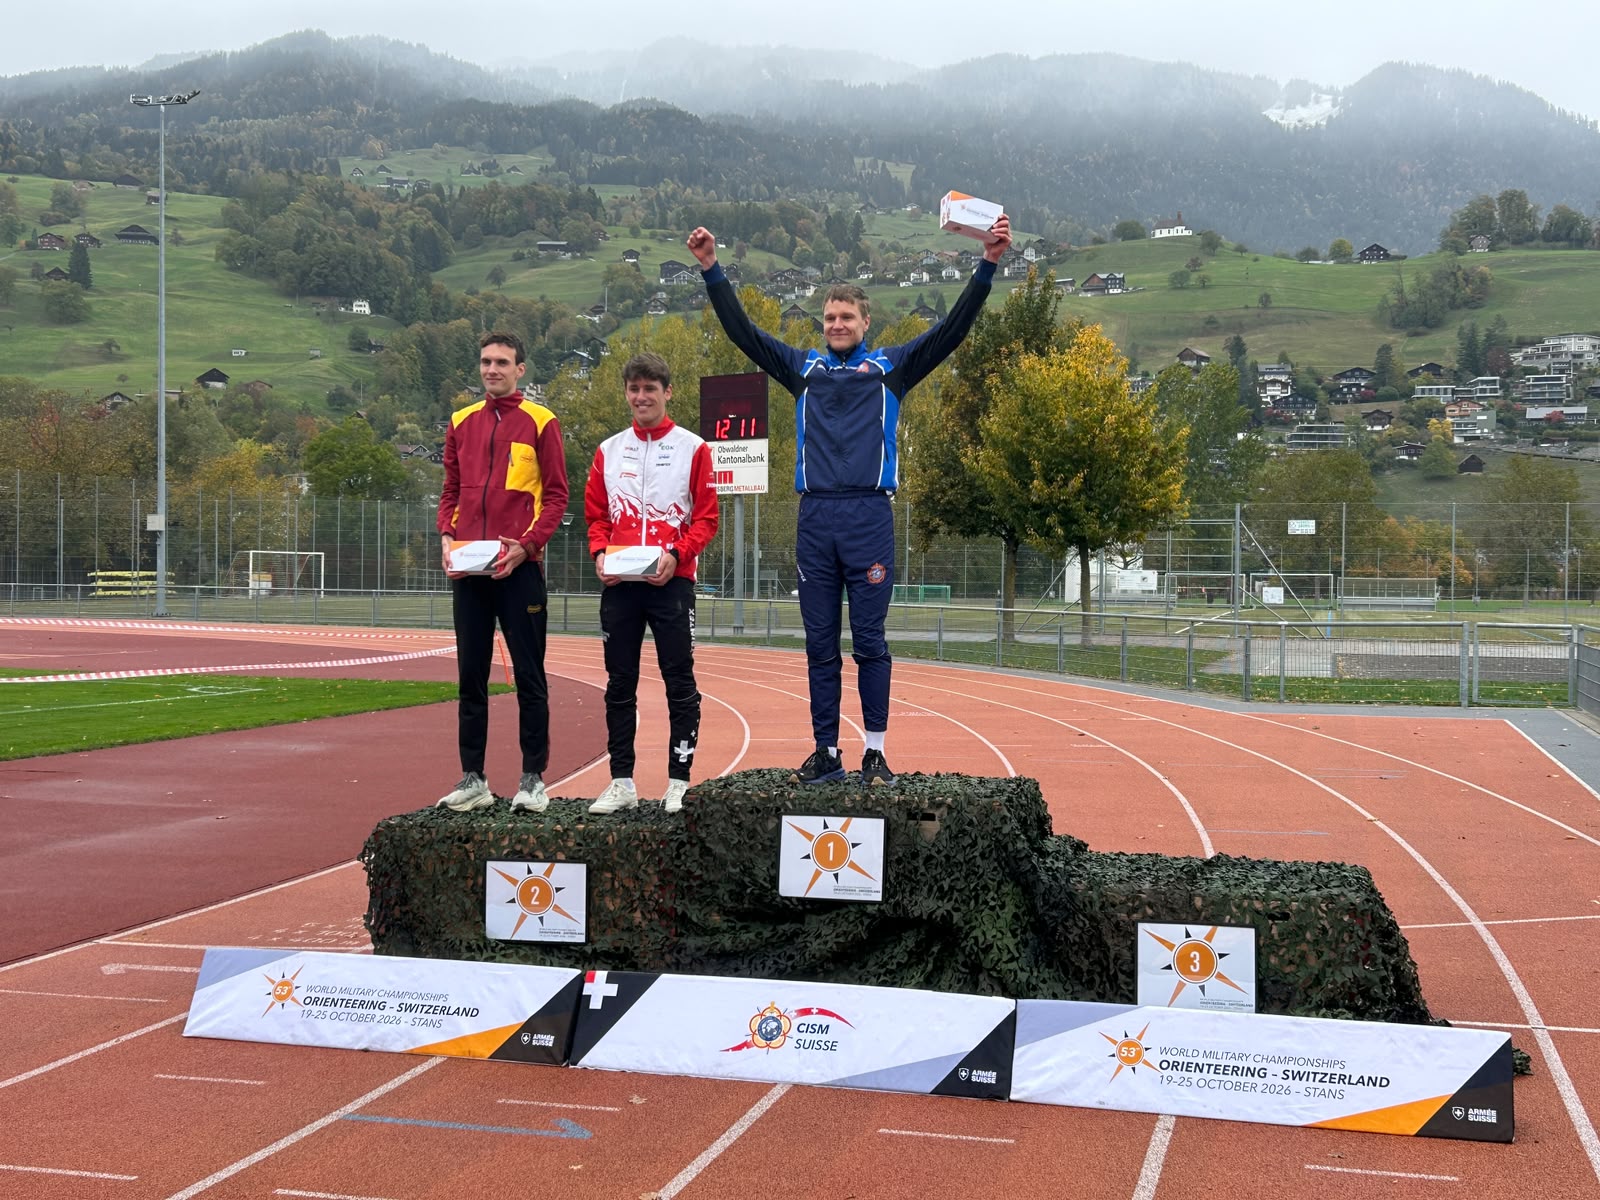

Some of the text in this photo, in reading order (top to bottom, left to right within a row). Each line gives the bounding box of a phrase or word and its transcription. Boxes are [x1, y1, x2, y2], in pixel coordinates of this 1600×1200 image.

[716, 418, 730, 439] 12
[717, 444, 748, 453] Obwaldner
[717, 453, 765, 464] Kantonalbank
[827, 841, 834, 861] 1
[530, 886, 540, 905] 2
[1190, 951, 1200, 972] 3
[306, 985, 449, 1002] WORLD MILITARY CHAMPIONSHIPS
[303, 996, 387, 1011] ORIENTEERING
[396, 1002, 480, 1018] SWITZERLAND
[301, 1009, 327, 1020] 19-25
[329, 1011, 376, 1023] OCTOBER
[377, 1014, 402, 1025] 2026
[410, 1017, 443, 1029] STANS
[797, 1023, 830, 1035] CISM
[532, 1039, 554, 1047] SUISSE
[794, 1038, 839, 1051] SUISSE
[1160, 1047, 1346, 1070] WORLD MILITARY CHAMPIONSHIPS
[971, 1069, 997, 1077] ARMÉE
[971, 1075, 996, 1084] SUISSE
[1159, 1059, 1267, 1079] ORIENTEERING
[1281, 1069, 1390, 1088] SWITZERLAND
[1160, 1075, 1193, 1088] 19-25
[1196, 1078, 1257, 1093] OCTOBER
[1260, 1083, 1291, 1096] 2026
[1304, 1086, 1345, 1100] STANS
[1468, 1108, 1497, 1116] ARMÉE
[1468, 1114, 1497, 1123] SUISSE
